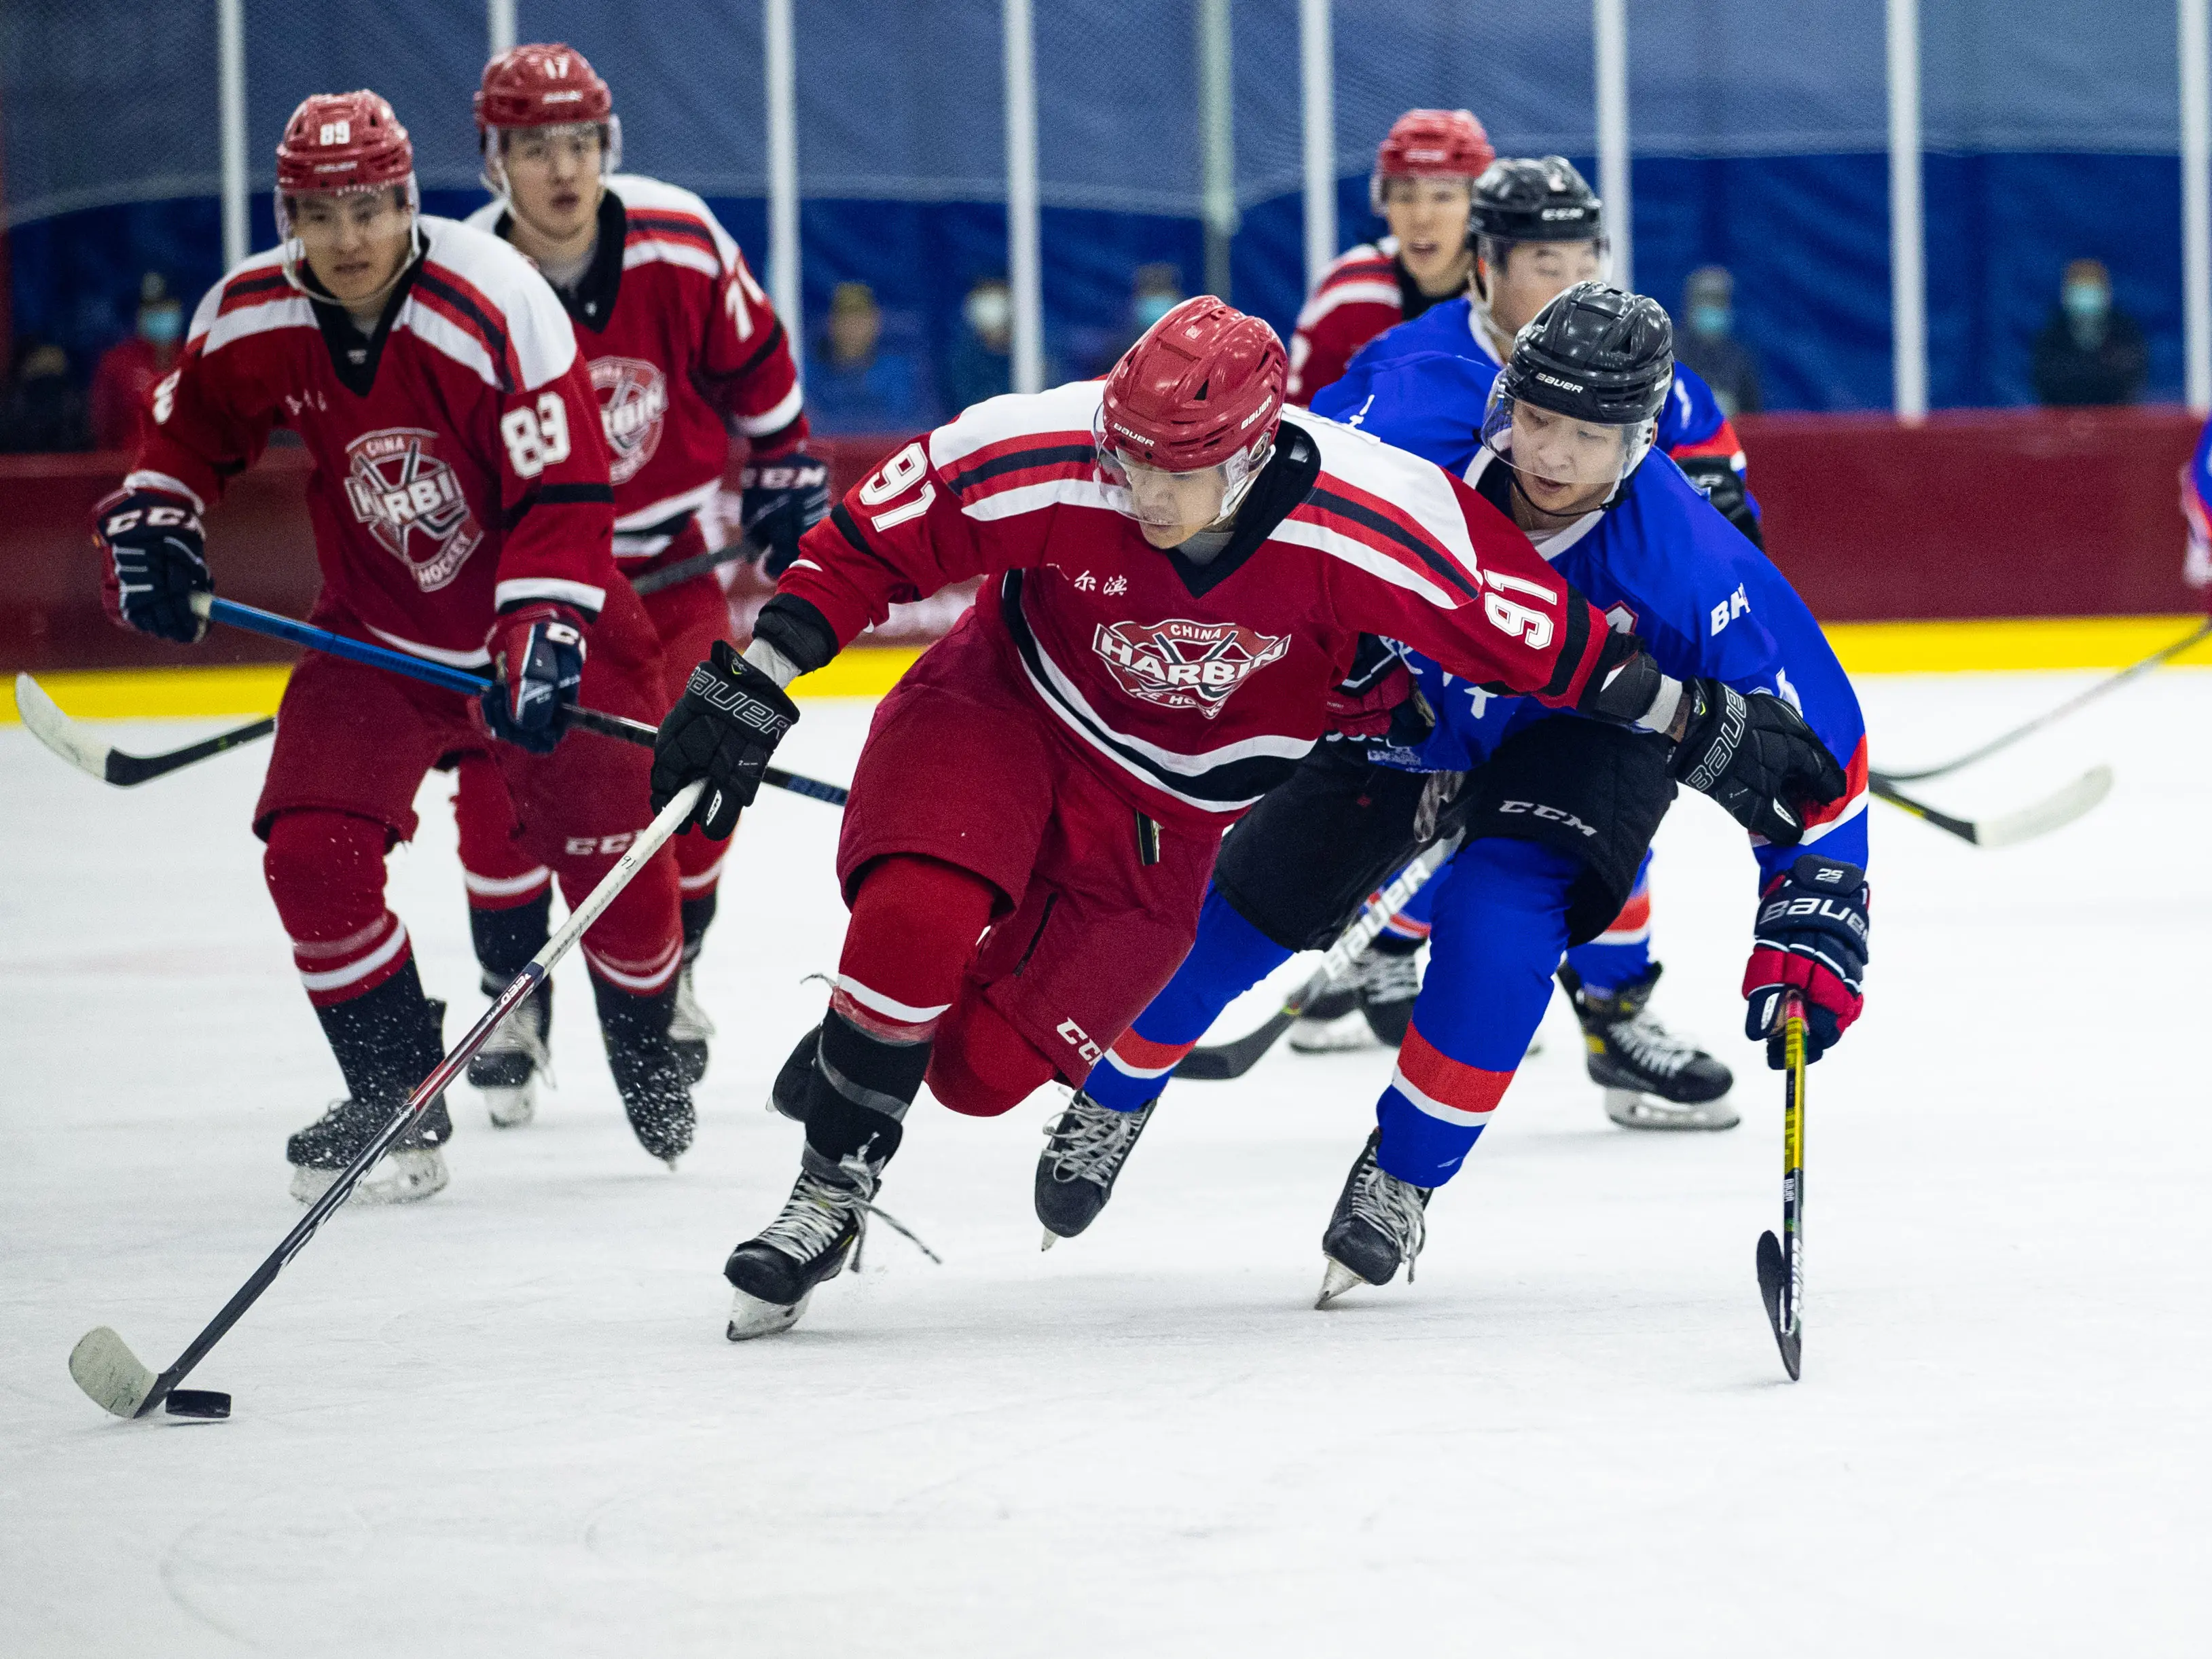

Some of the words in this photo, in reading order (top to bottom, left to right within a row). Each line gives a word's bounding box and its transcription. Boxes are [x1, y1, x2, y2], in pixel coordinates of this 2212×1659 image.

[544, 54, 570, 80] 17
[320, 120, 350, 146] 89
[1535, 372, 1584, 394] BAUER
[1241, 395, 1273, 430] BAUER
[1113, 422, 1155, 447] BAUER
[858, 441, 937, 533] 91
[1483, 568, 1557, 650] 91
[1170, 624, 1222, 640] CHINA
[1100, 632, 1285, 686] HARBIN
[687, 666, 793, 741] AUER
[1685, 684, 1747, 792] BAUE
[1499, 800, 1597, 837] CCM
[1323, 857, 1431, 981] BAUER
